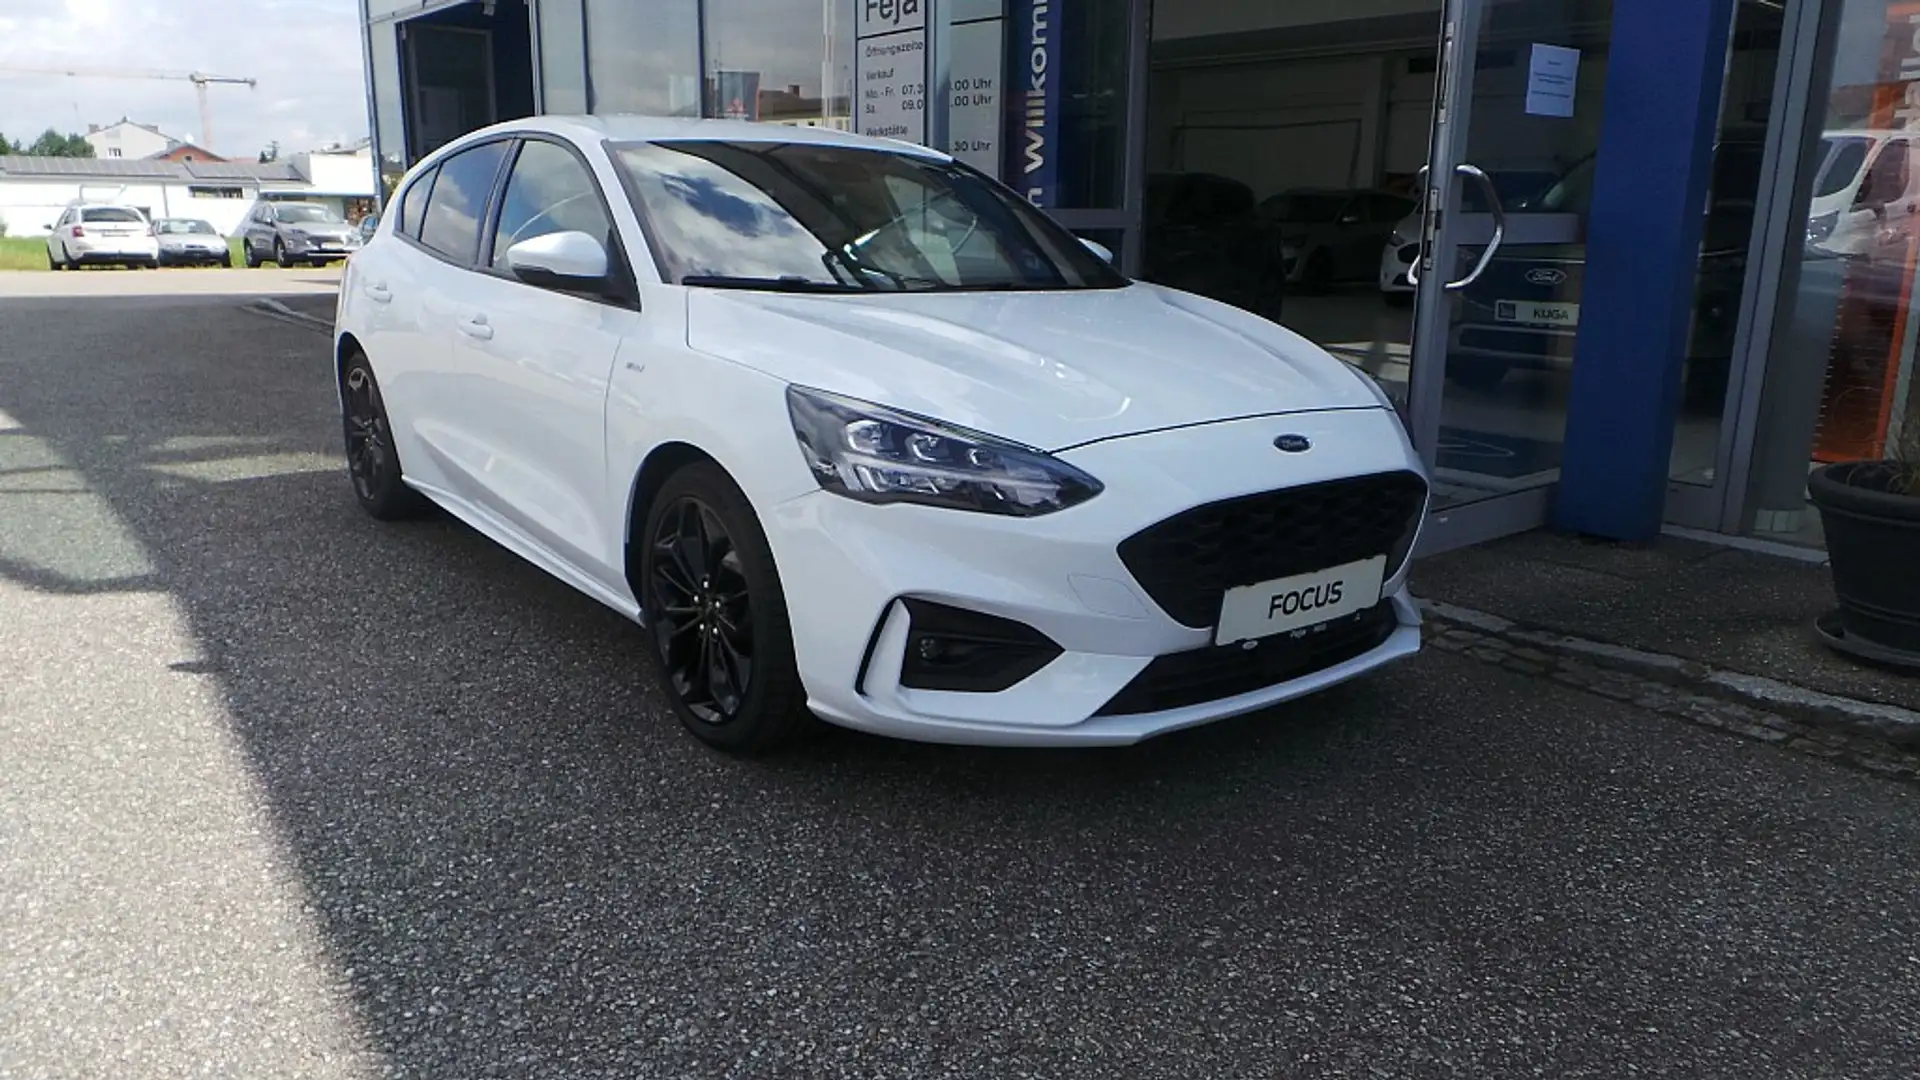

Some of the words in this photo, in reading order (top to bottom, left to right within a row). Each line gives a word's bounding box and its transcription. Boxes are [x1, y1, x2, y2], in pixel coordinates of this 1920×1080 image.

[866, 41, 924, 57] Öffnungszeite
[973, 78, 992, 90] Uhr
[973, 94, 992, 107] Uhr
[972, 140, 992, 152] Uhr
[1533, 306, 1569, 321] KUGA
[1267, 580, 1344, 620] FOCUS
